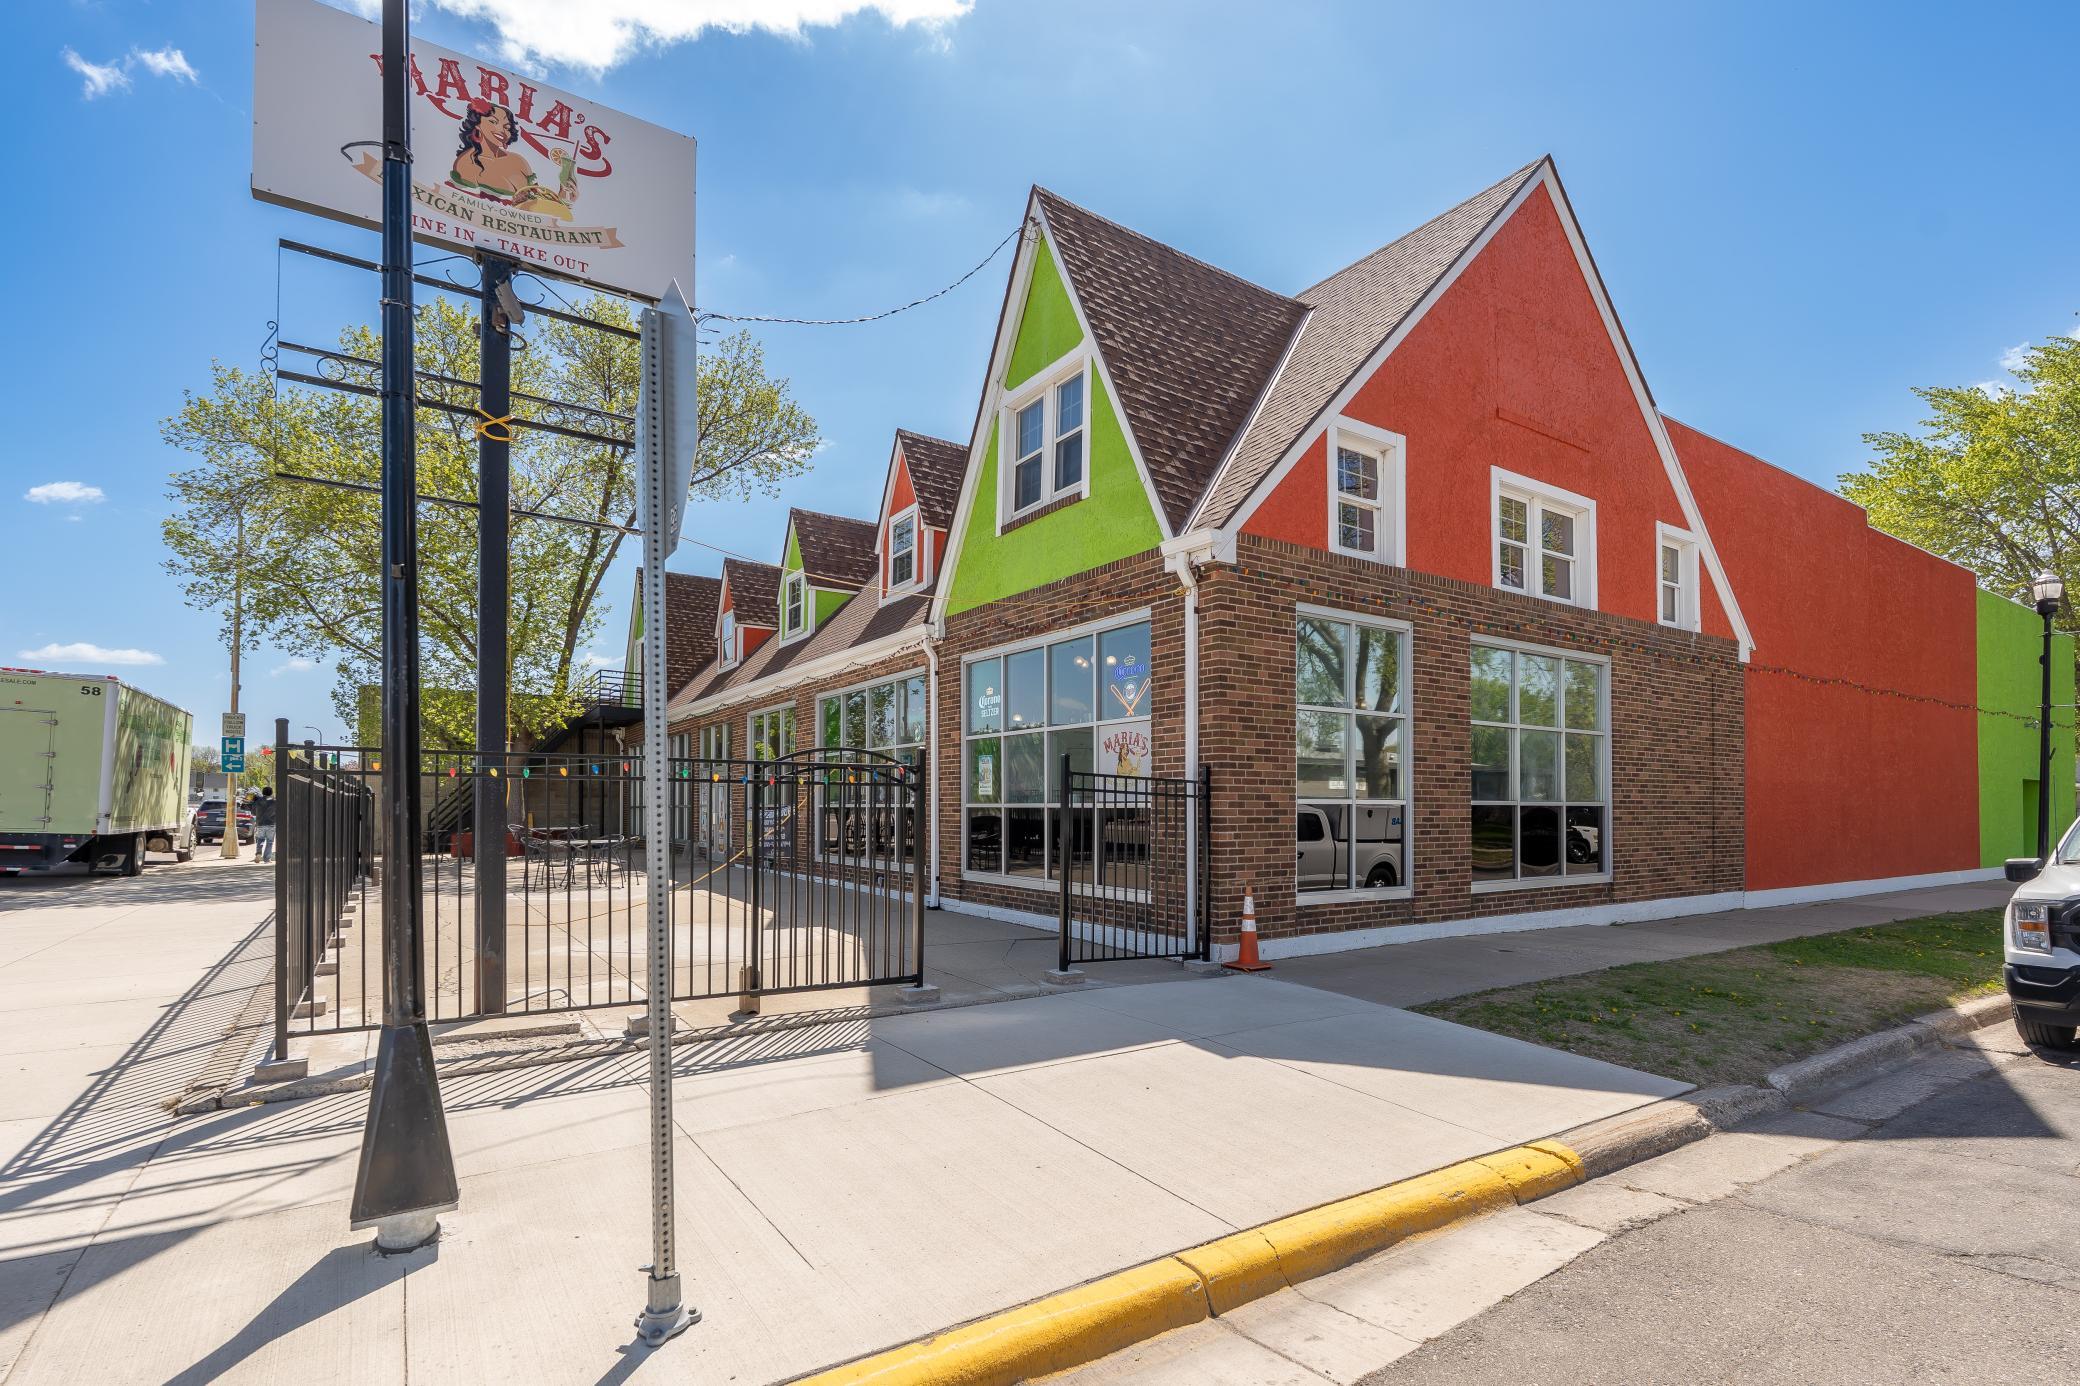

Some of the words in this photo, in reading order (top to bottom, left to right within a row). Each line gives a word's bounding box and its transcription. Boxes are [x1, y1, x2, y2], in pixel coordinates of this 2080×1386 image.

[451, 192, 542, 224] FAMILY-OWNED
[411, 215, 447, 235] INE
[454, 226, 476, 242] IN
[497, 238, 547, 262] TAKE
[553, 254, 589, 273] OUT
[482, 214, 603, 245] RESTAURANT
[80, 686, 102, 696] 58
[1103, 731, 1149, 754] MARIA'S
